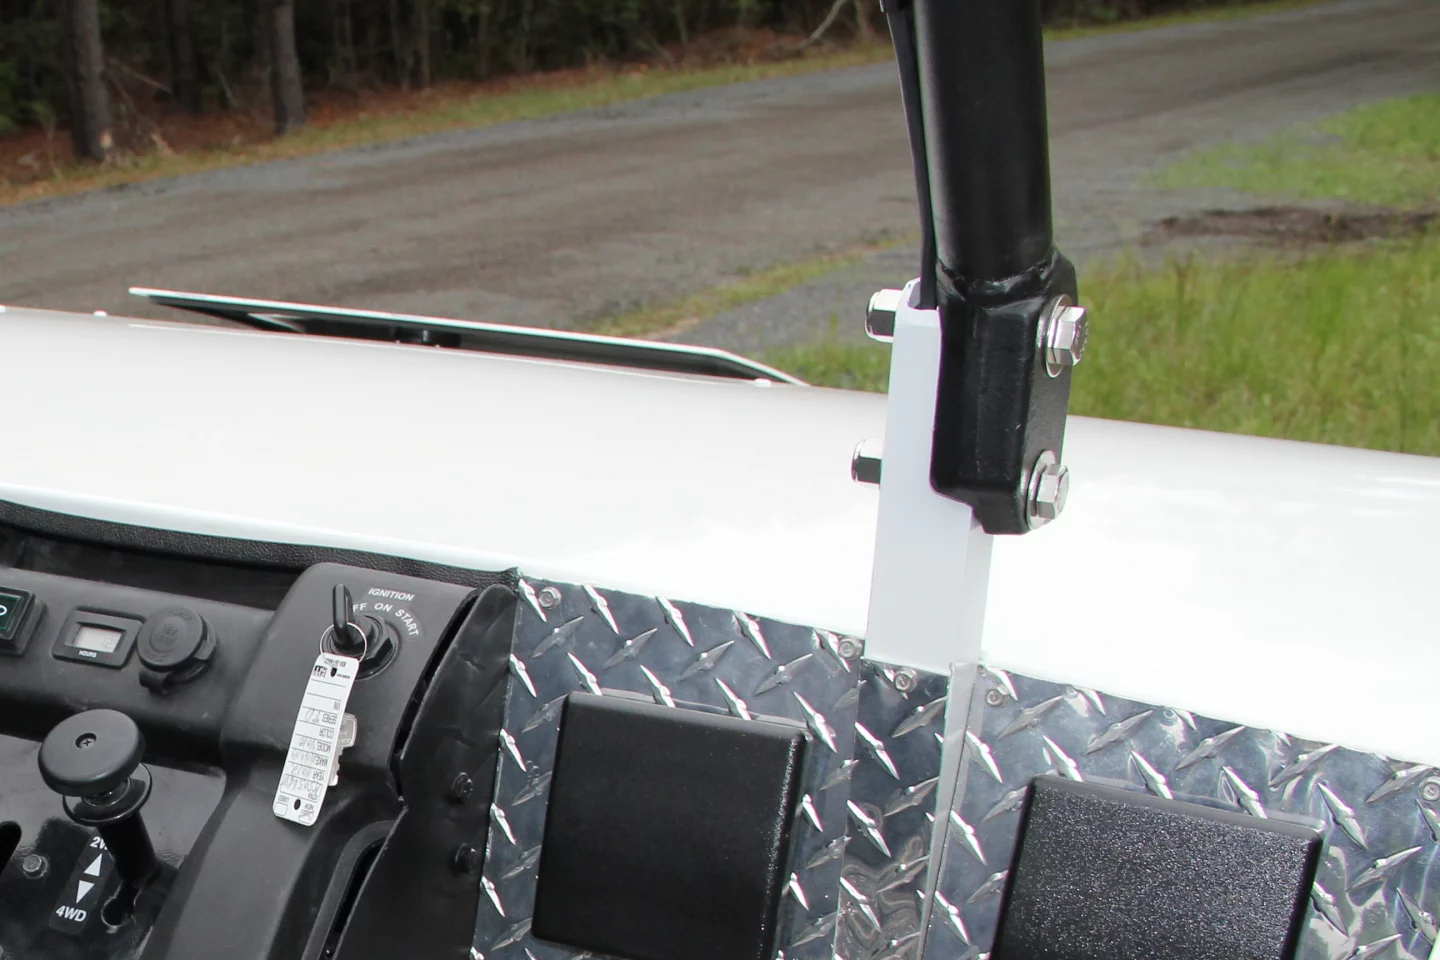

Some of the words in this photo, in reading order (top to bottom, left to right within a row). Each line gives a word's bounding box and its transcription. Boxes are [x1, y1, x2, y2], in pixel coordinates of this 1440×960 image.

[368, 588, 415, 601] IGNITION
[352, 602, 367, 612] FF
[374, 602, 393, 612] ON
[395, 609, 419, 636] START
[78, 650, 98, 659] HOURS
[318, 727, 335, 739] COLOR
[316, 741, 331, 753] MODEL
[55, 905, 87, 922] 4WD
